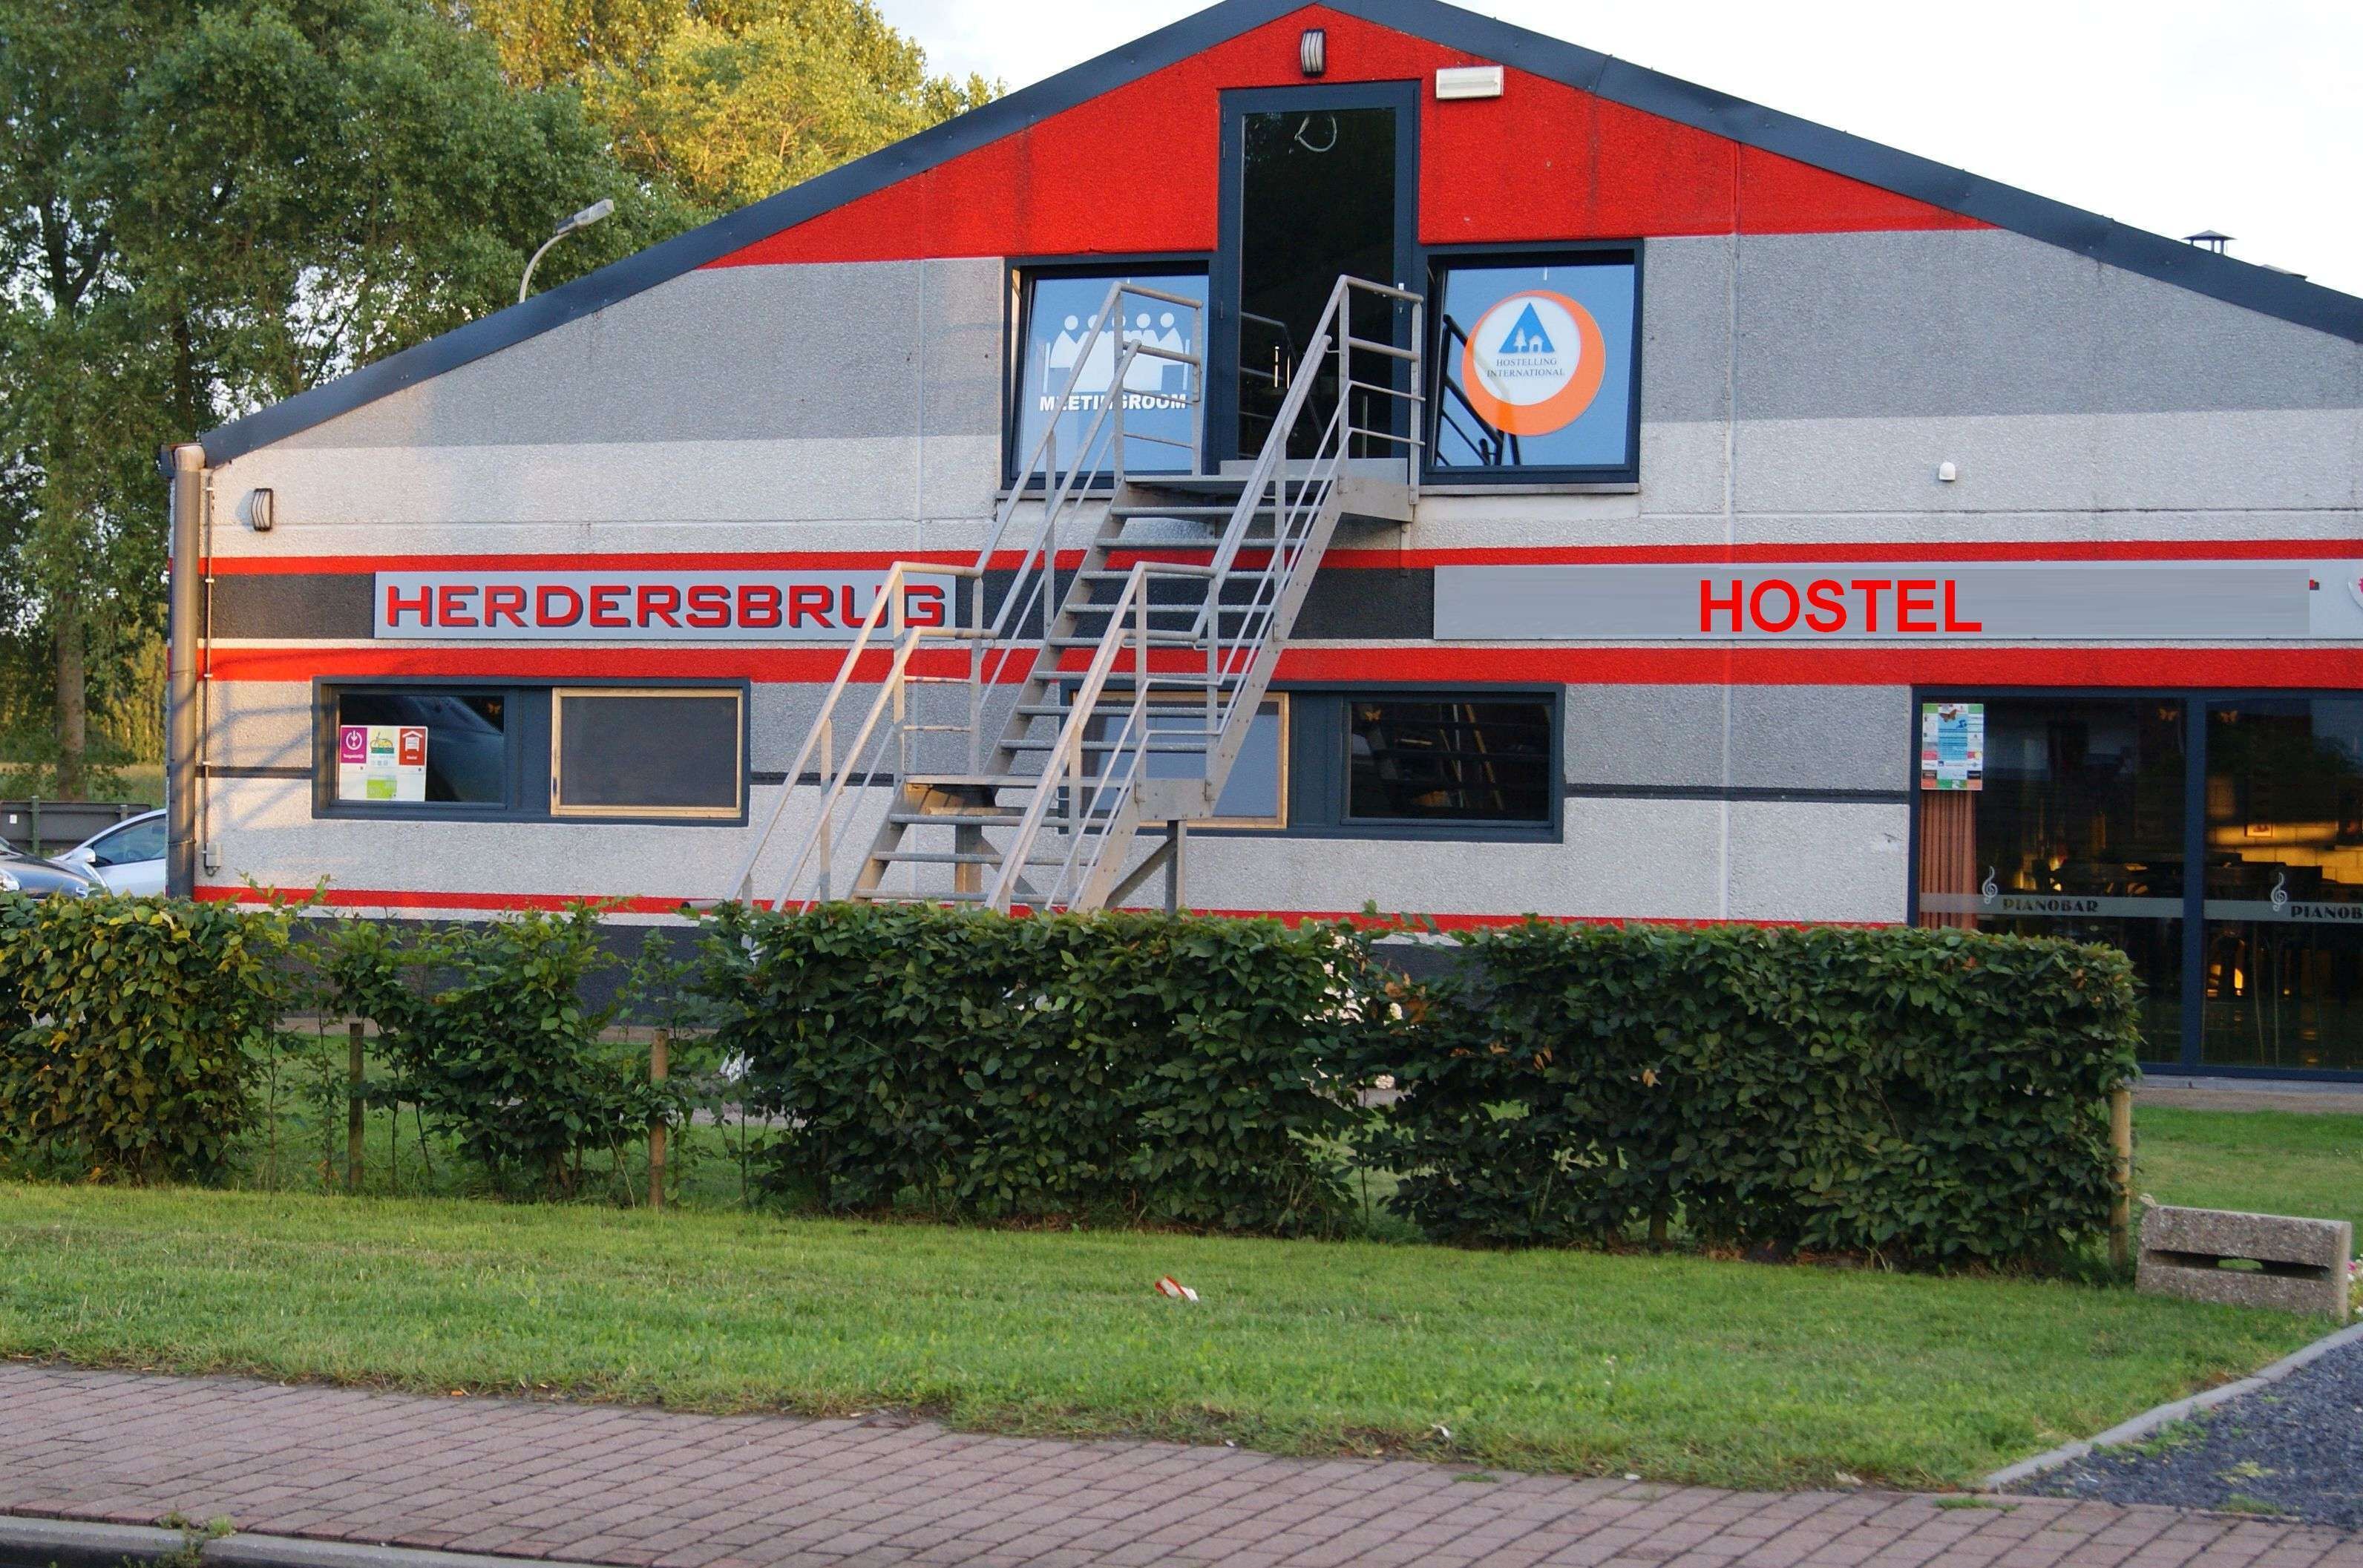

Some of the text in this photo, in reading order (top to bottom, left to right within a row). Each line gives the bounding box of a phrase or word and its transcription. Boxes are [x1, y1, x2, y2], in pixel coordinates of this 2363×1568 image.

[1496, 358, 1557, 367] HOSTELLING
[1487, 368, 1565, 378] INTERNATIONAL
[1039, 394, 1186, 410] METIROOM
[387, 585, 945, 628] HERDERSBRUG
[2003, 898, 2099, 913] PIANOBAR
